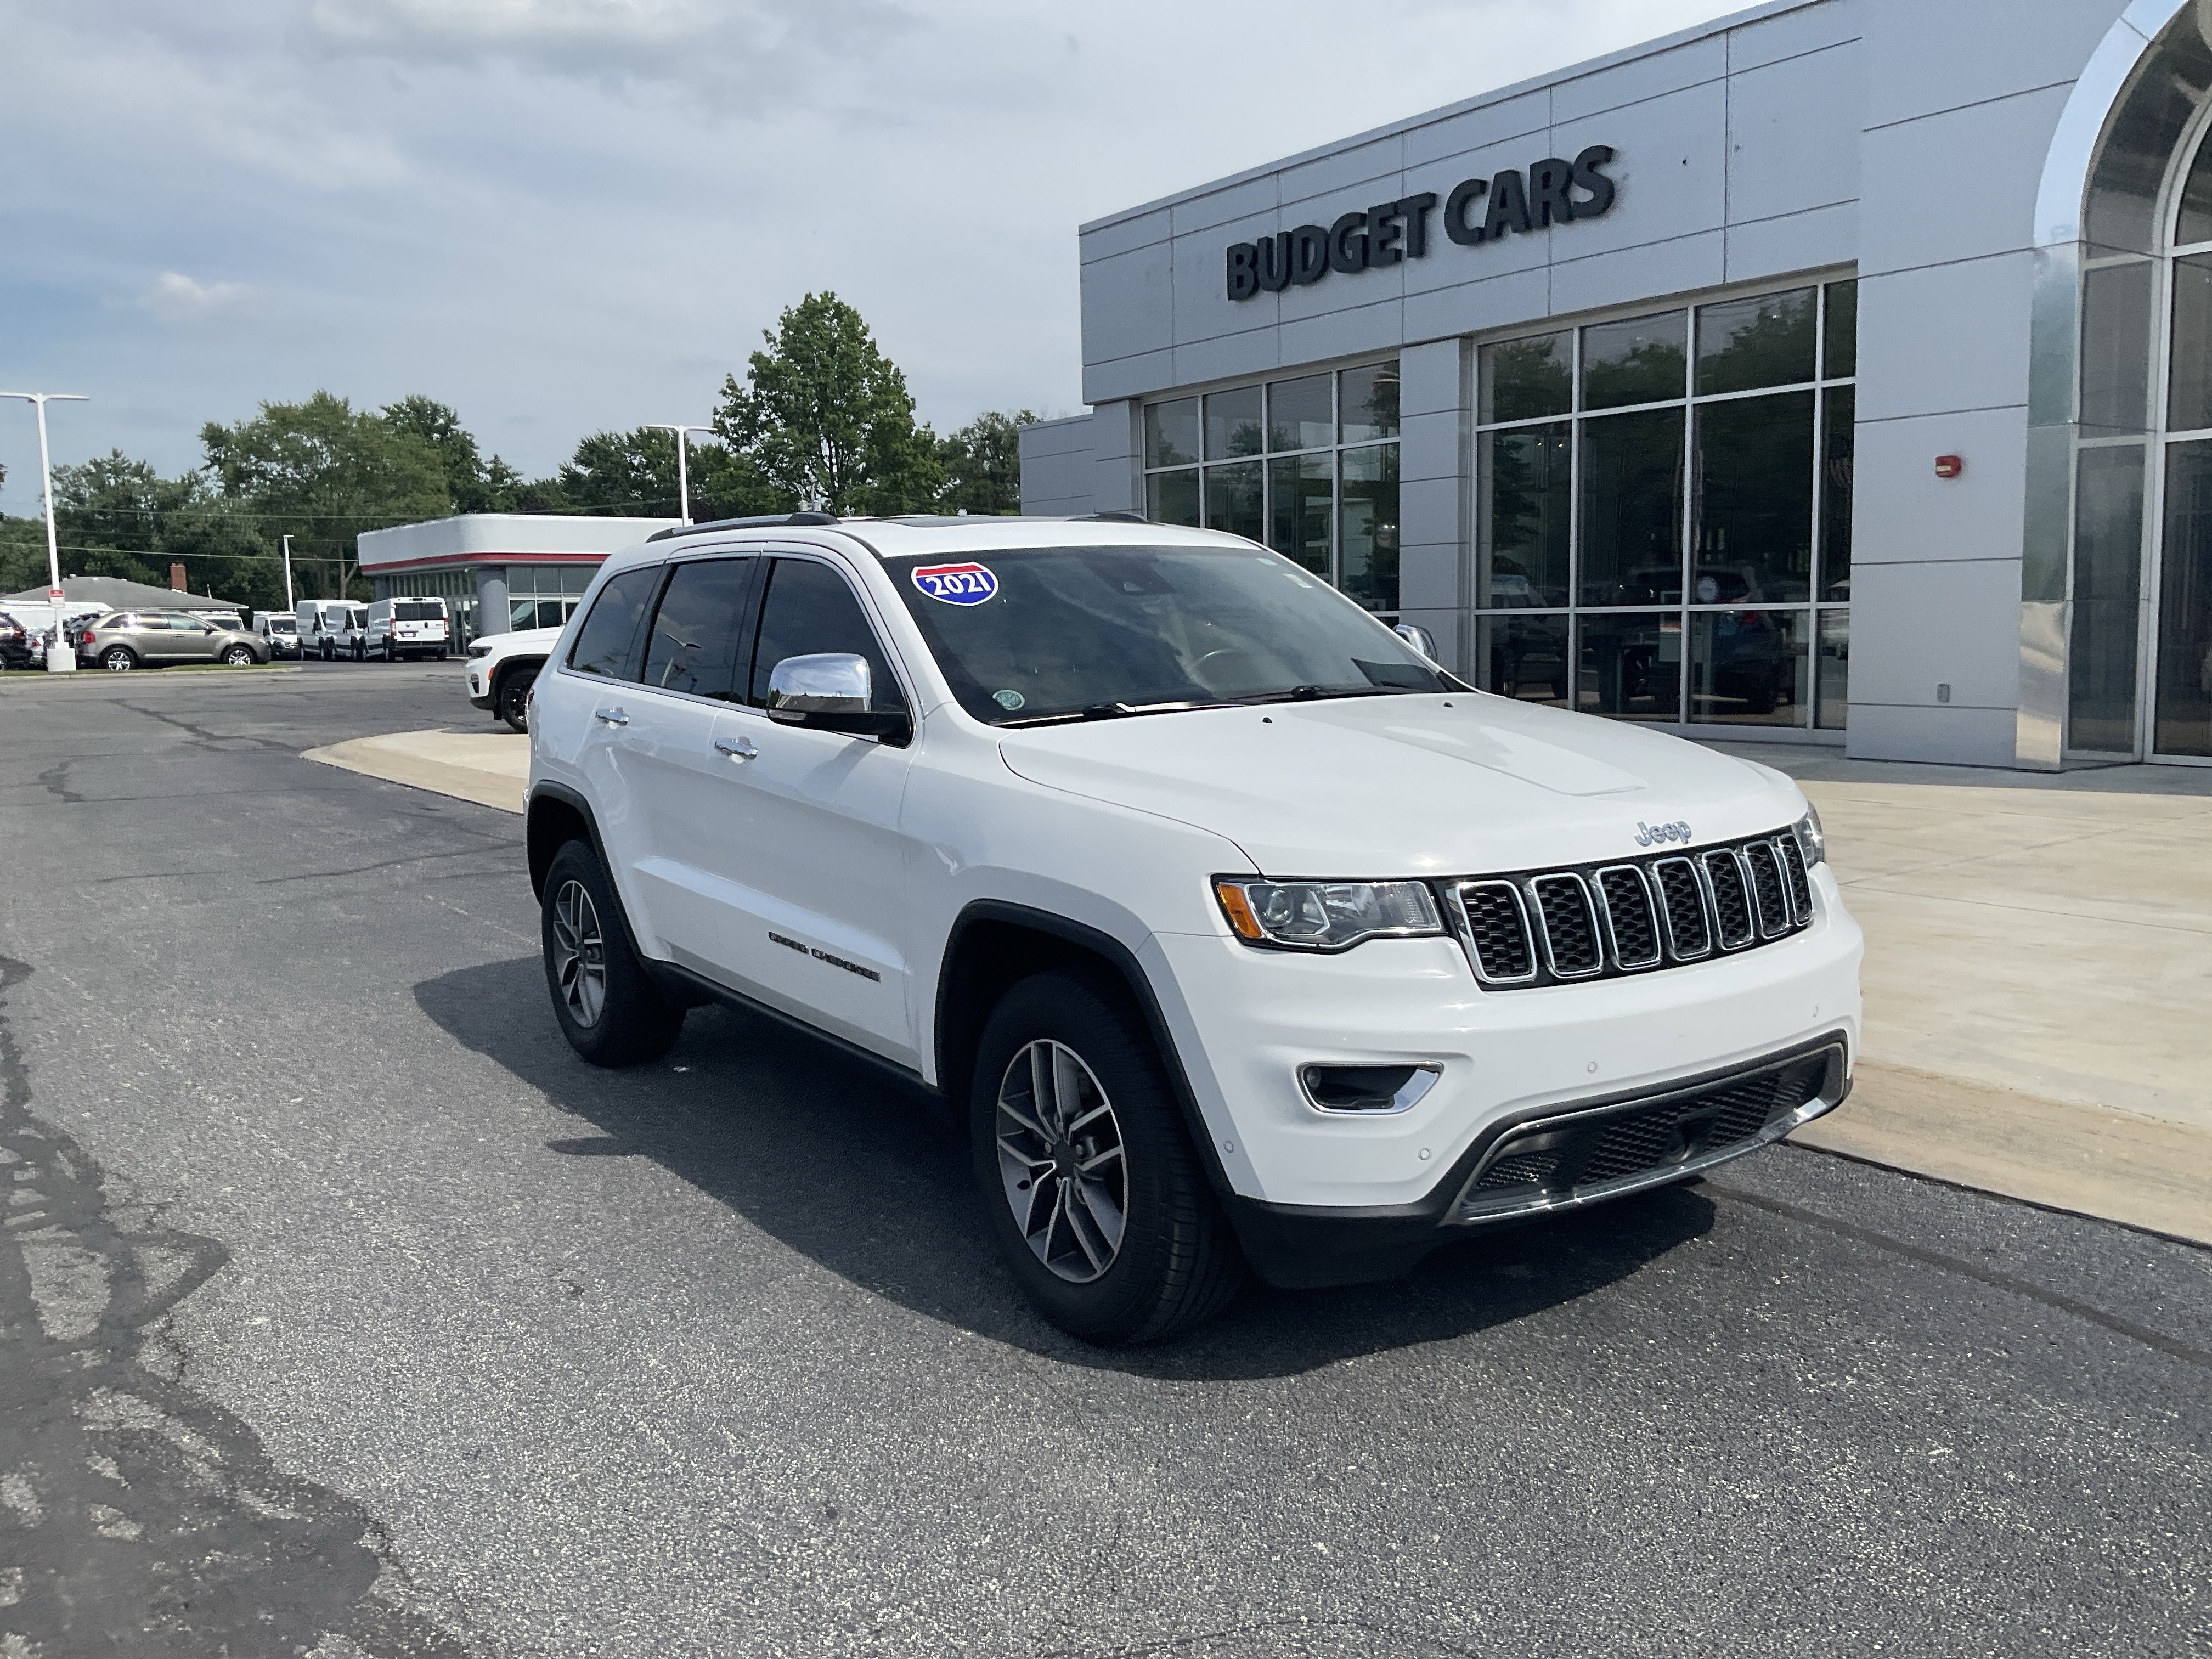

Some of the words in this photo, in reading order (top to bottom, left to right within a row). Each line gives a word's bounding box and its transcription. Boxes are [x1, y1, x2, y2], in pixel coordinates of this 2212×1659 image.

[1227, 191, 1437, 301] BUDGET
[1443, 145, 1616, 245] CARS
[924, 572, 992, 596] 2021
[1634, 821, 1692, 847] Jeep
